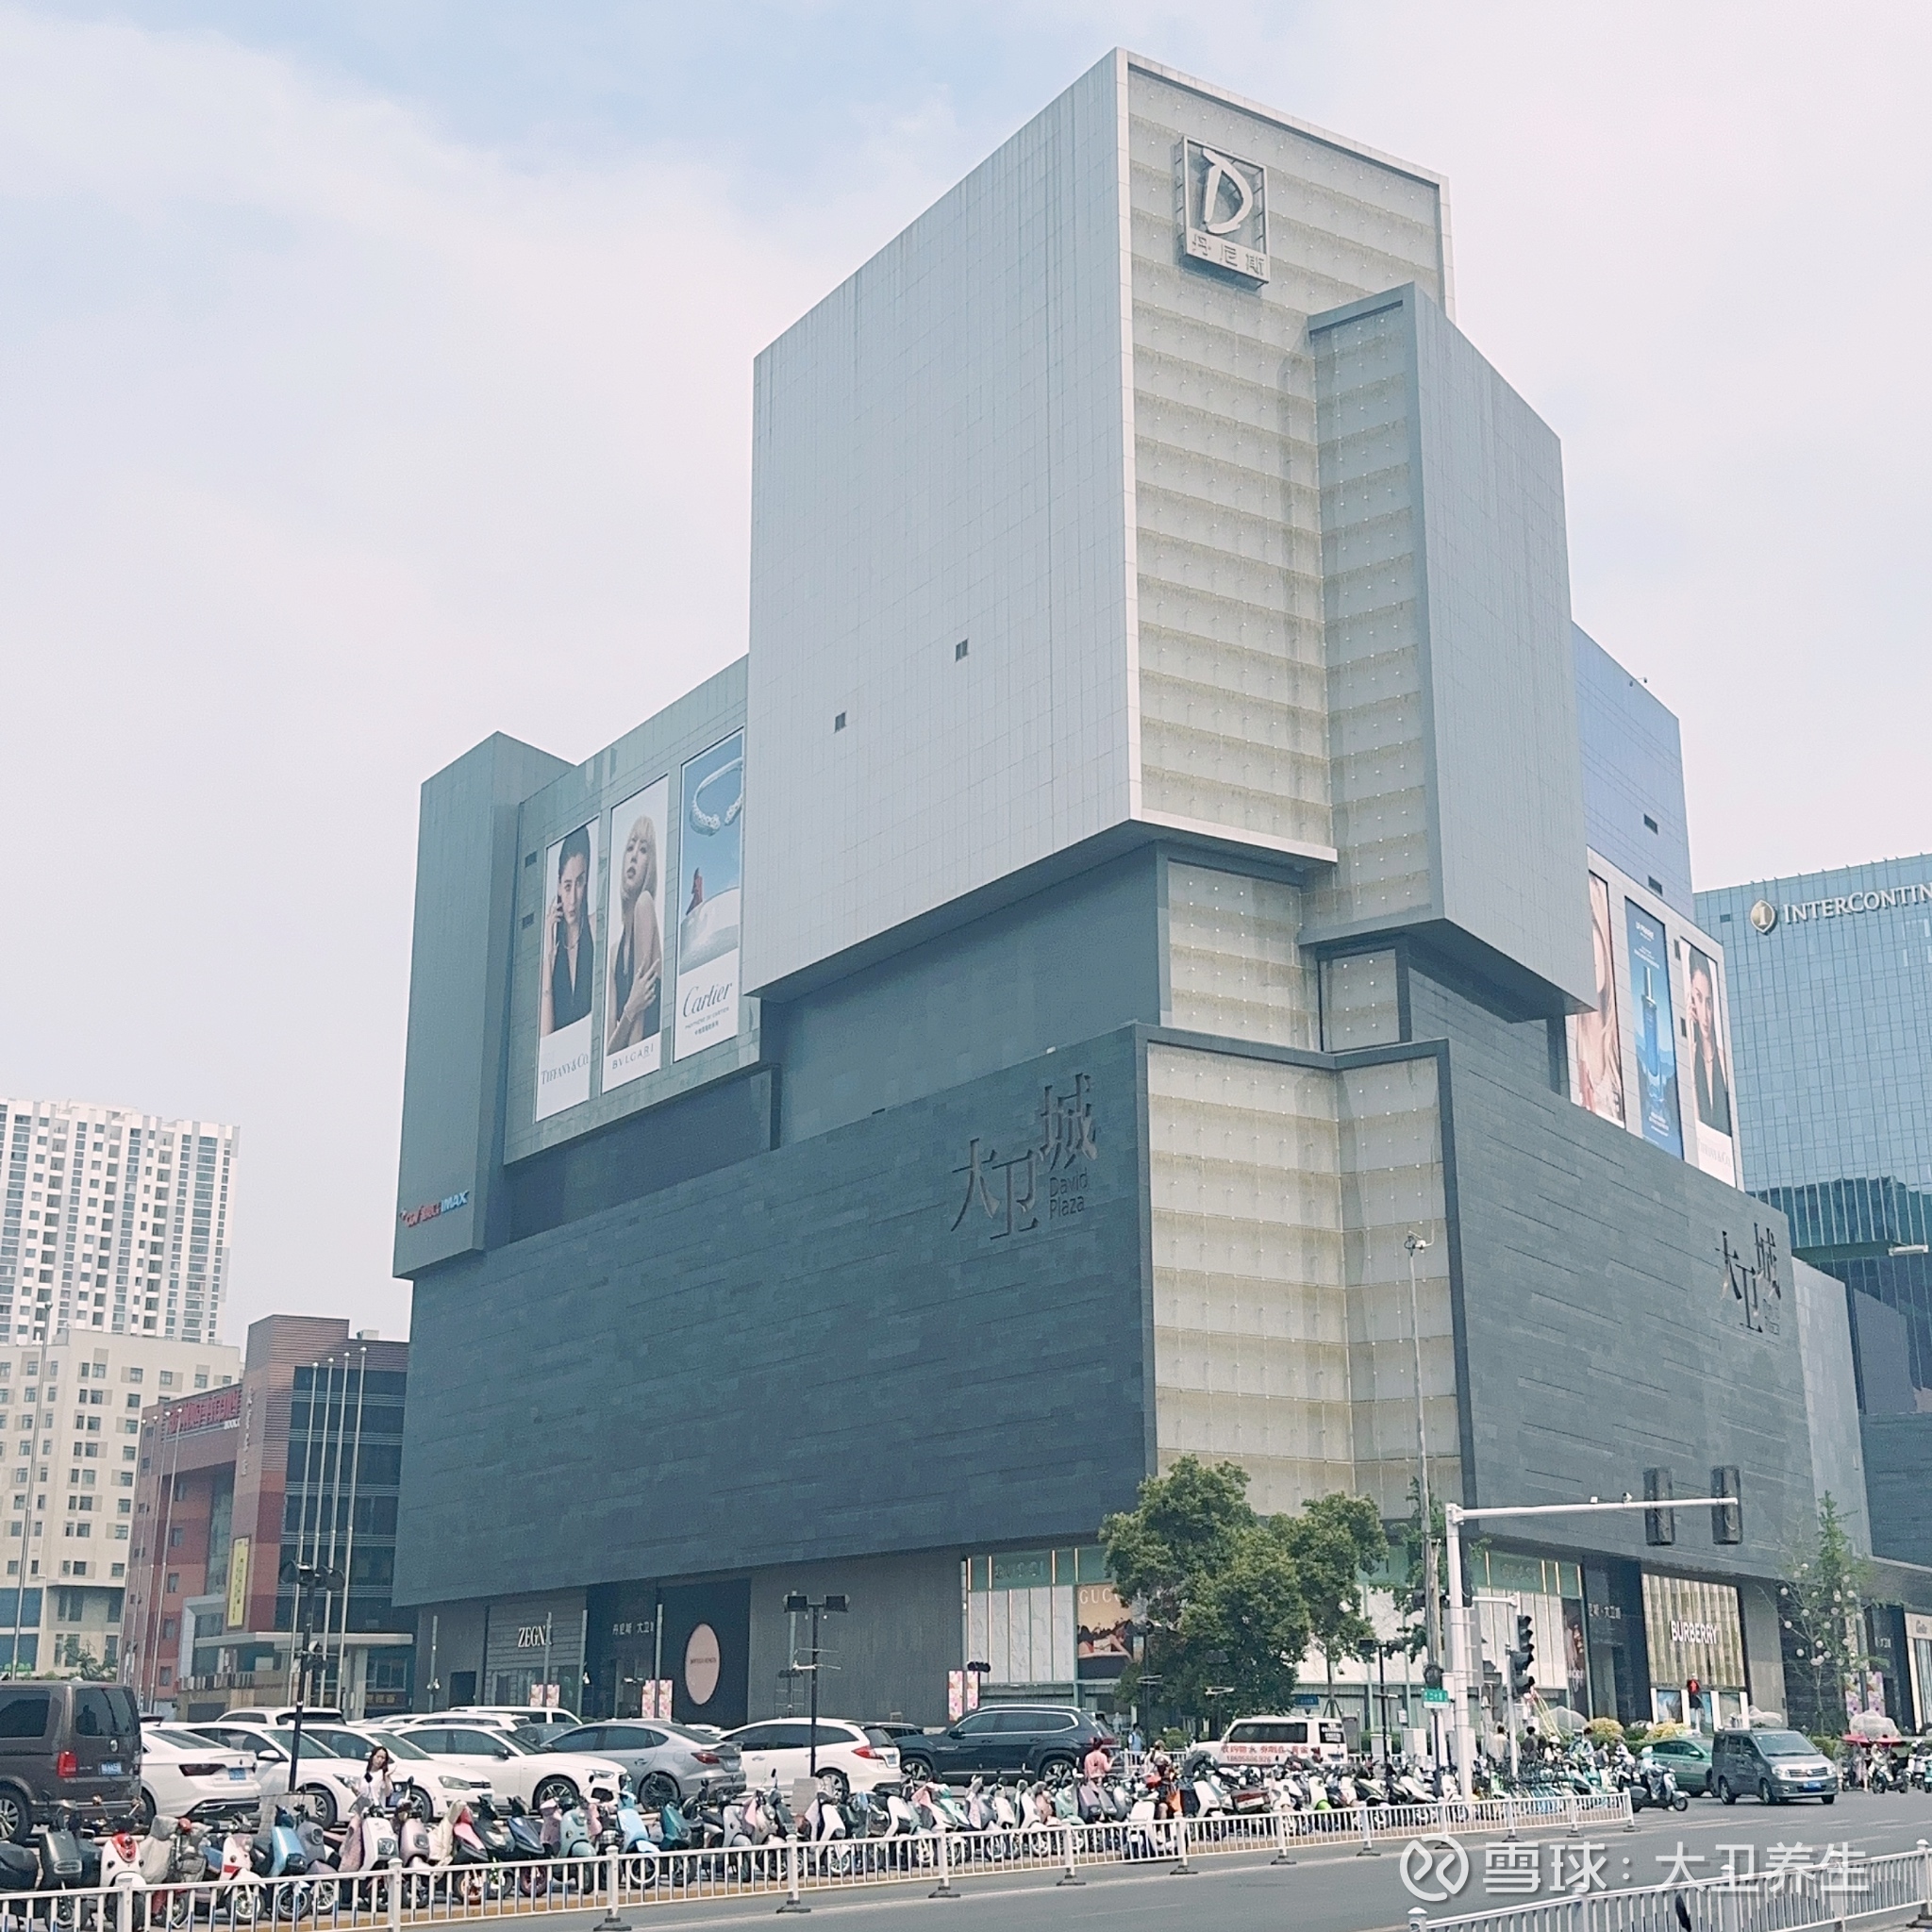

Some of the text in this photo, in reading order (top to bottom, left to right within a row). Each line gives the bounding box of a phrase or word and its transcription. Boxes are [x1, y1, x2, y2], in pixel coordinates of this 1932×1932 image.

[1202, 147, 1254, 235] D
[683, 982, 733, 1018] Cartier
[611, 1043, 654, 1070] BVLGARI
[1048, 1168, 1089, 1198] David
[441, 1190, 470, 1212] IMAX
[1048, 1194, 1086, 1220] Plaza
[1670, 1620, 1717, 1645] BURBERRY
